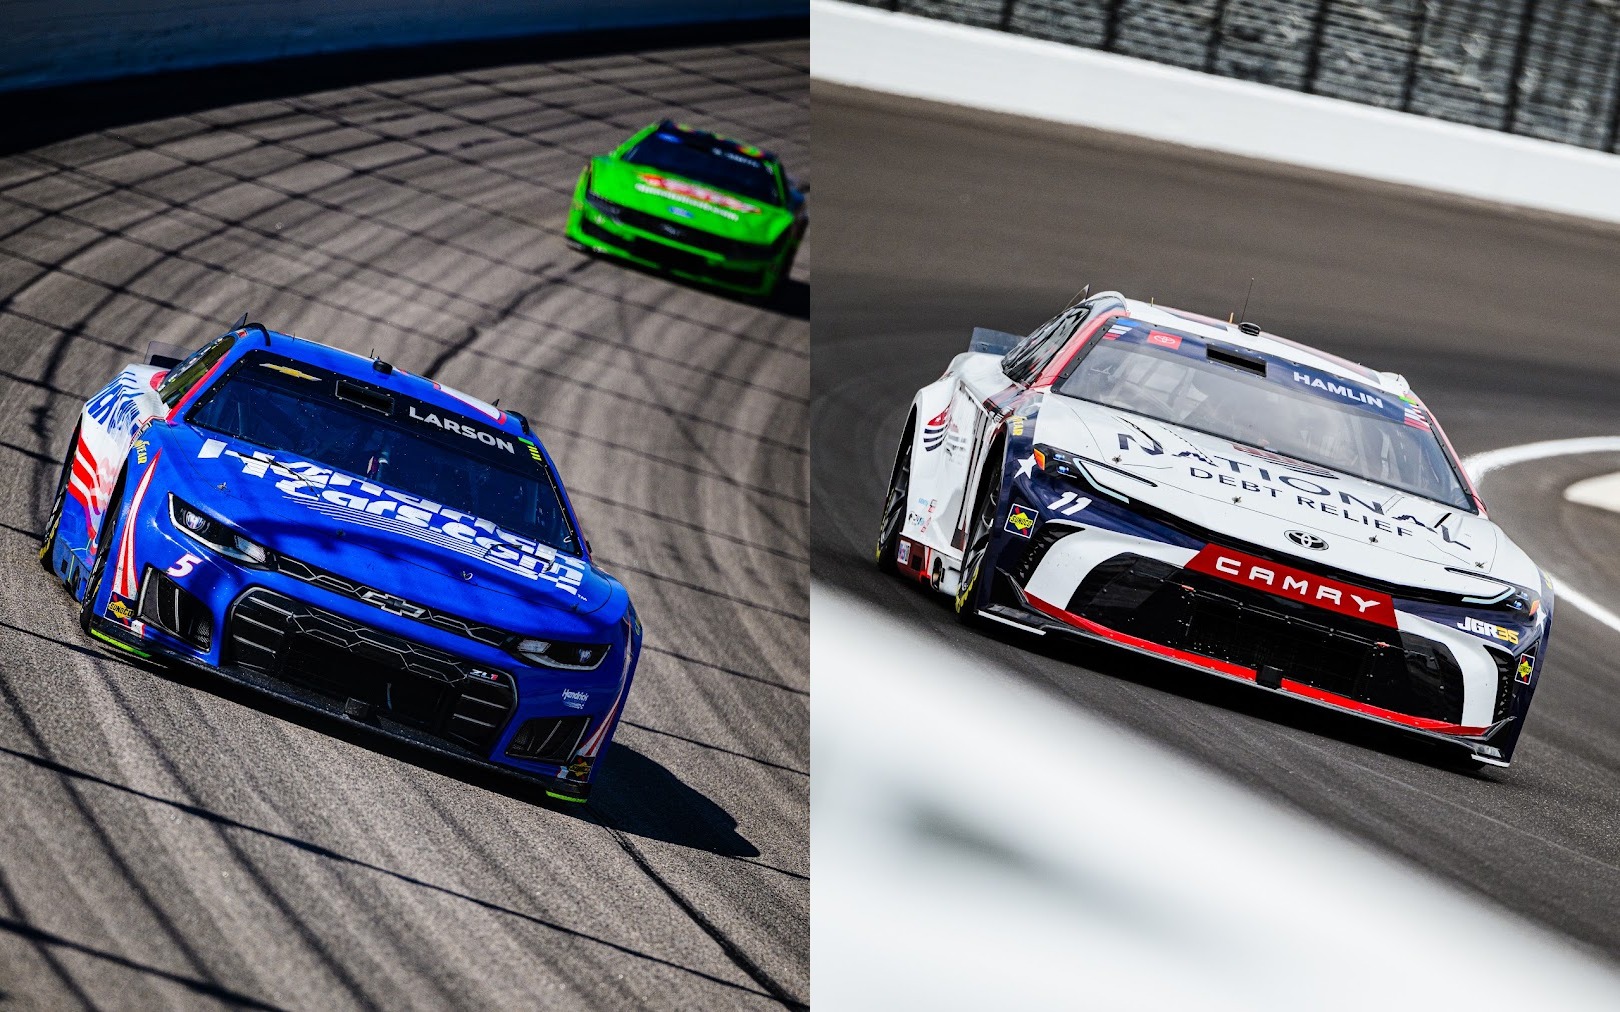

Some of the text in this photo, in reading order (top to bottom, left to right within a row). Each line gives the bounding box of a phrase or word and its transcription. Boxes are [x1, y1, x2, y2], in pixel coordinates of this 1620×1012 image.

[1293, 371, 1384, 409] HAMLIN
[409, 406, 515, 454] LARSON
[1047, 491, 1092, 516] 11
[1117, 432, 1472, 550] NATIONAL
[1190, 467, 1413, 537] DEBT RELIEF
[1010, 515, 1032, 527] SUNOCO
[167, 554, 202, 577] 5
[1215, 556, 1381, 613] CAMRY
[108, 602, 134, 617] SUNOCO
